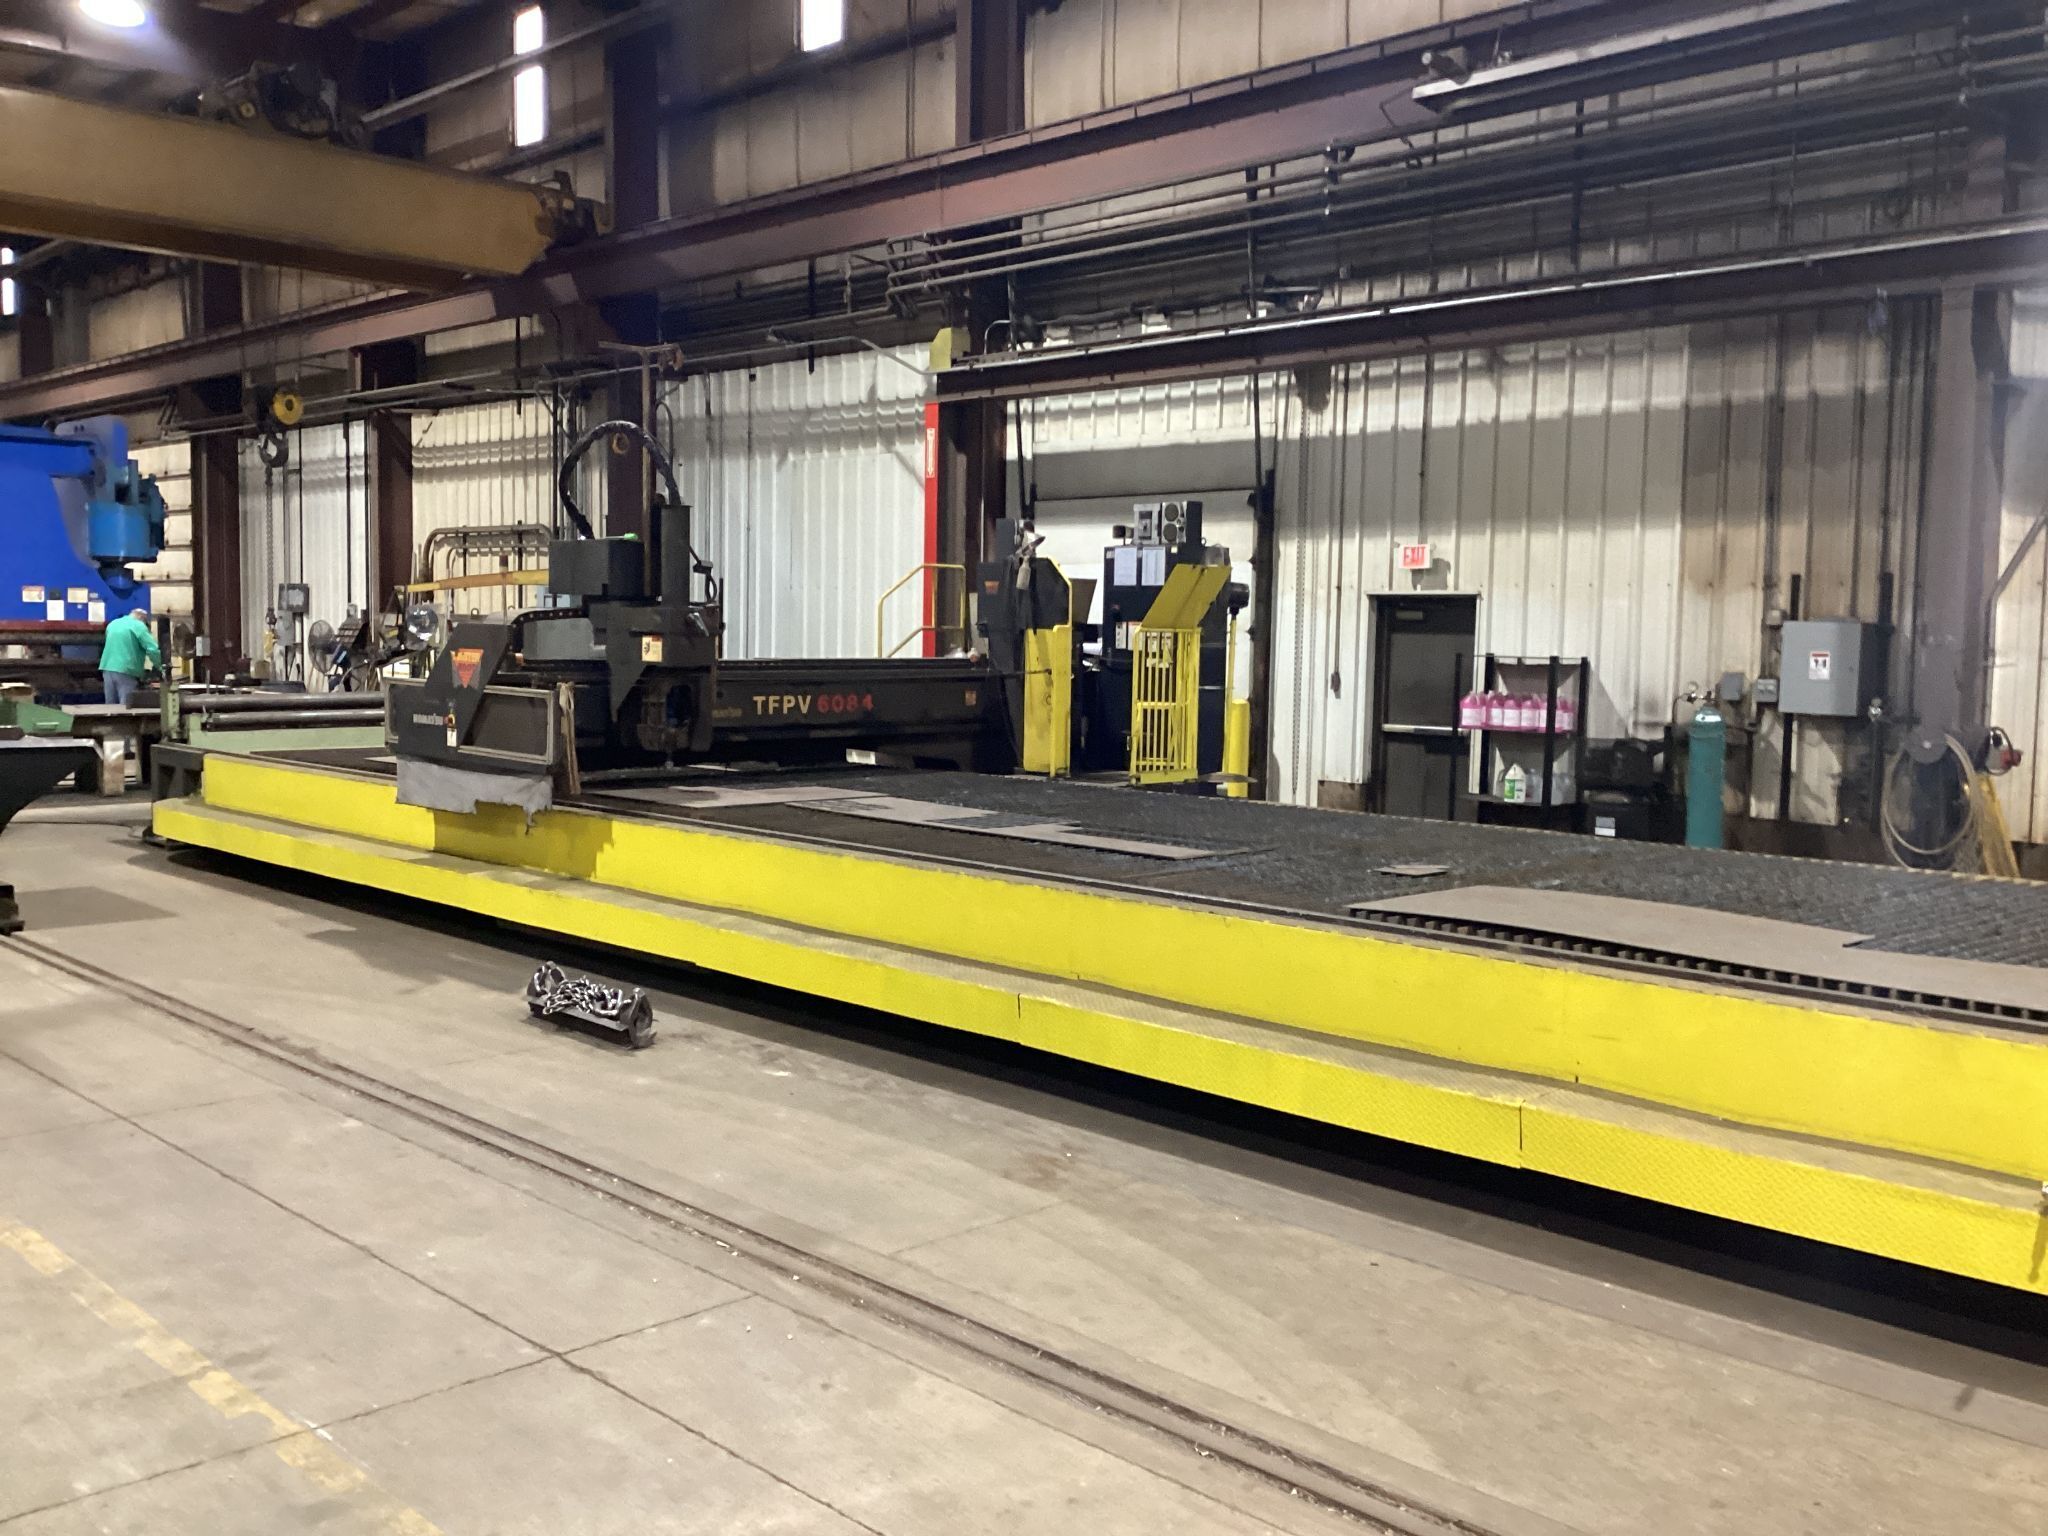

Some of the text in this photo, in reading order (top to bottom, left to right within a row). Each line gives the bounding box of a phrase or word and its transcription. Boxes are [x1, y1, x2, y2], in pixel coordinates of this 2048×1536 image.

[1404, 546, 1426, 566] EXIT
[752, 695, 811, 714] TFPV
[817, 693, 874, 713] 6084
